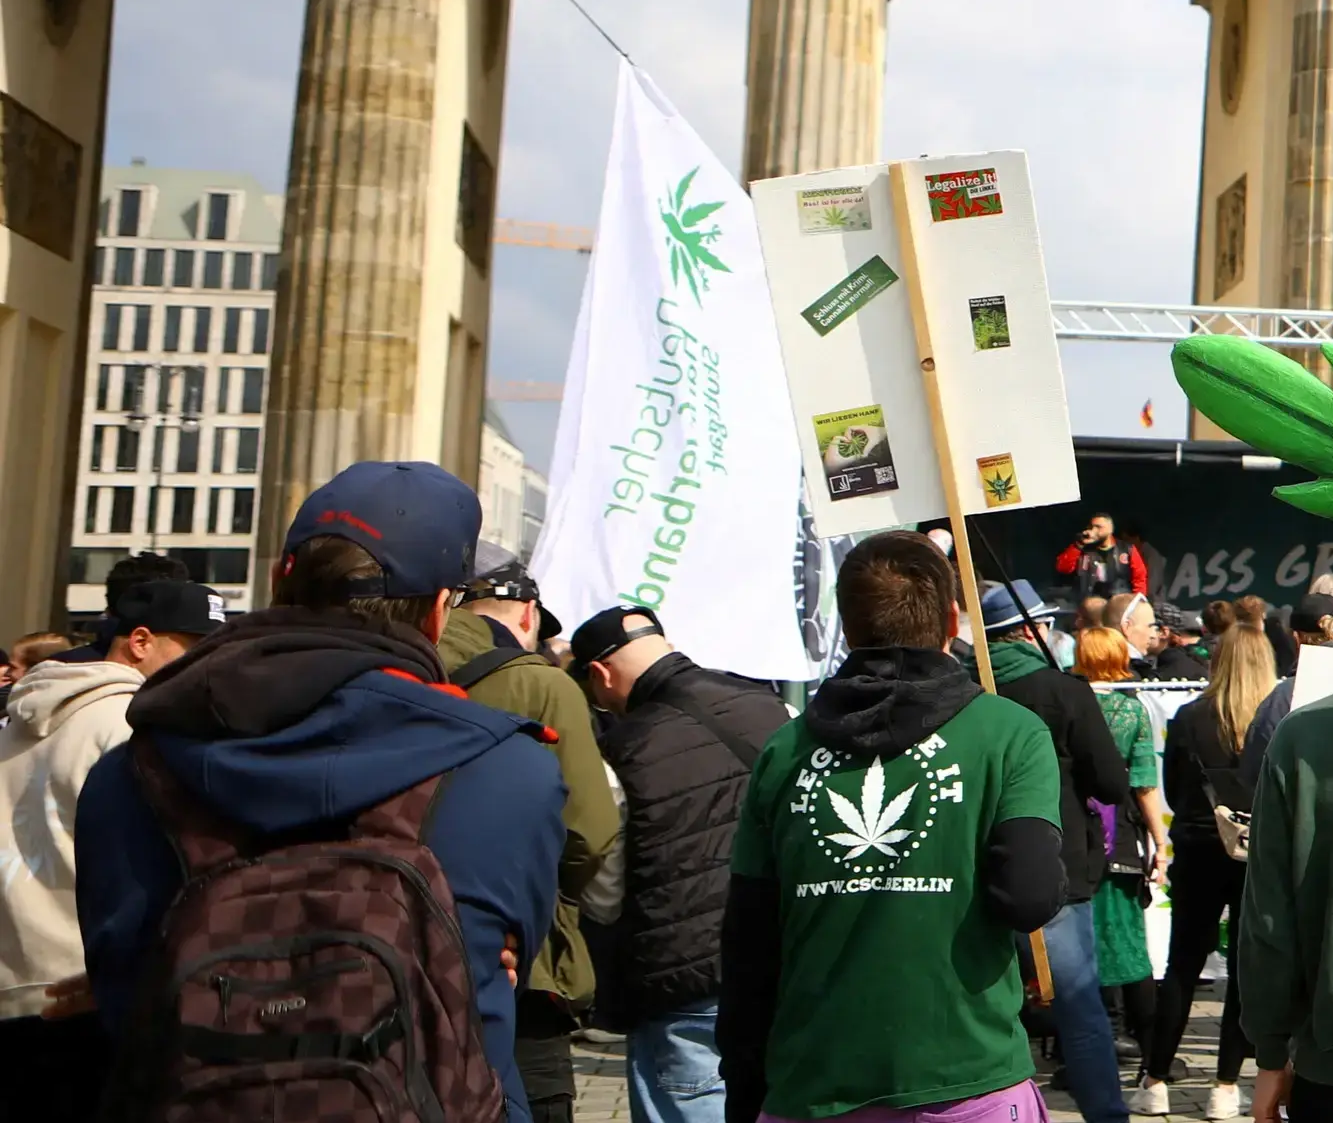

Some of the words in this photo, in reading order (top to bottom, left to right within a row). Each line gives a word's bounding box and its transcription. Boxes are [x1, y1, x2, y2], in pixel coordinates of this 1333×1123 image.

[926, 177, 981, 192] Legalize
[982, 173, 998, 184] It!
[813, 298, 840, 321] Schluss
[838, 287, 852, 301] mit
[820, 299, 851, 327] Cannabis
[831, 412, 858, 423] LIEBEN
[859, 409, 880, 417] HANF
[1167, 547, 1256, 599] ASS
[936, 763, 964, 803] IT
[796, 877, 954, 898] WWW.CSC.BERLIN
